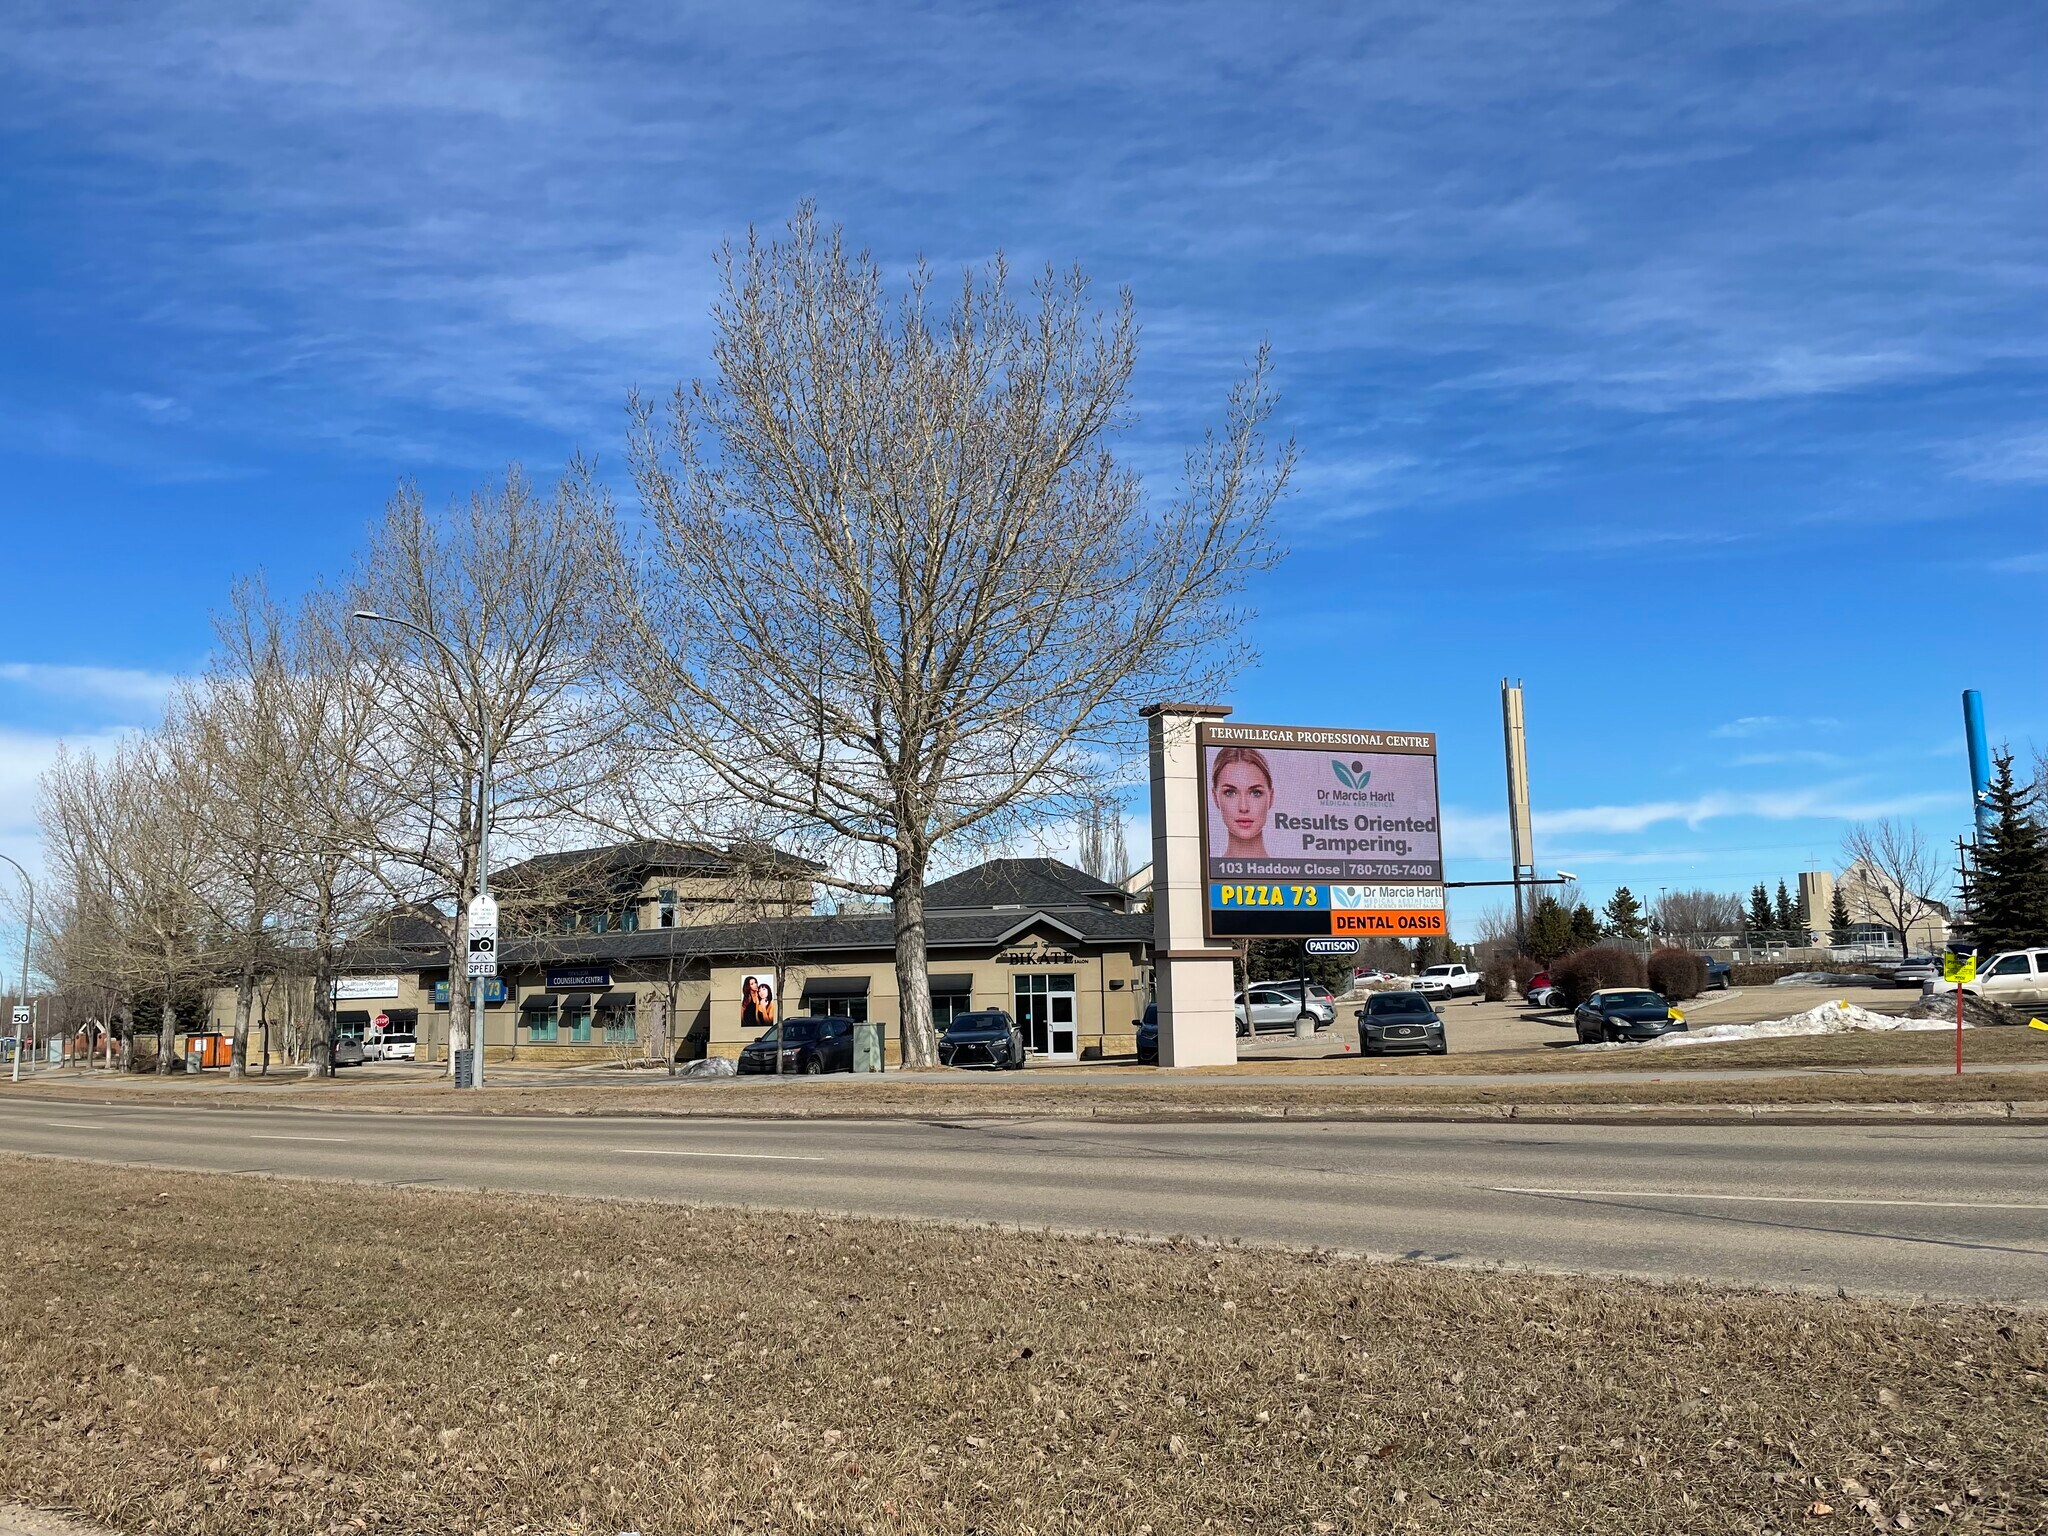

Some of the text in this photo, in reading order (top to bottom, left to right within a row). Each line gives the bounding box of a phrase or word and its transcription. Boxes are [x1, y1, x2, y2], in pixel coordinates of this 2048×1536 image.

[1209, 727, 1430, 748] TERWILLEGAR PROFESSIONAL CENTRE
[1317, 789, 1329, 800] Dr
[1333, 790, 1367, 801] Marcia
[1274, 813, 1437, 832] Results Oriented
[1302, 834, 1413, 856] Pampering.
[1219, 862, 1341, 875] 103 Haddow Close
[1349, 864, 1433, 876] 780-705-7400
[1221, 885, 1318, 906] PIZZA 73
[1363, 887, 1442, 898] Dr Marcia Hartt
[1336, 916, 1441, 929] DENTAL OASIS
[1310, 941, 1355, 951] PATTISON
[469, 965, 495, 973] SPEED
[584, 976, 603, 984] CENTRE
[14, 1014, 28, 1022] 50
